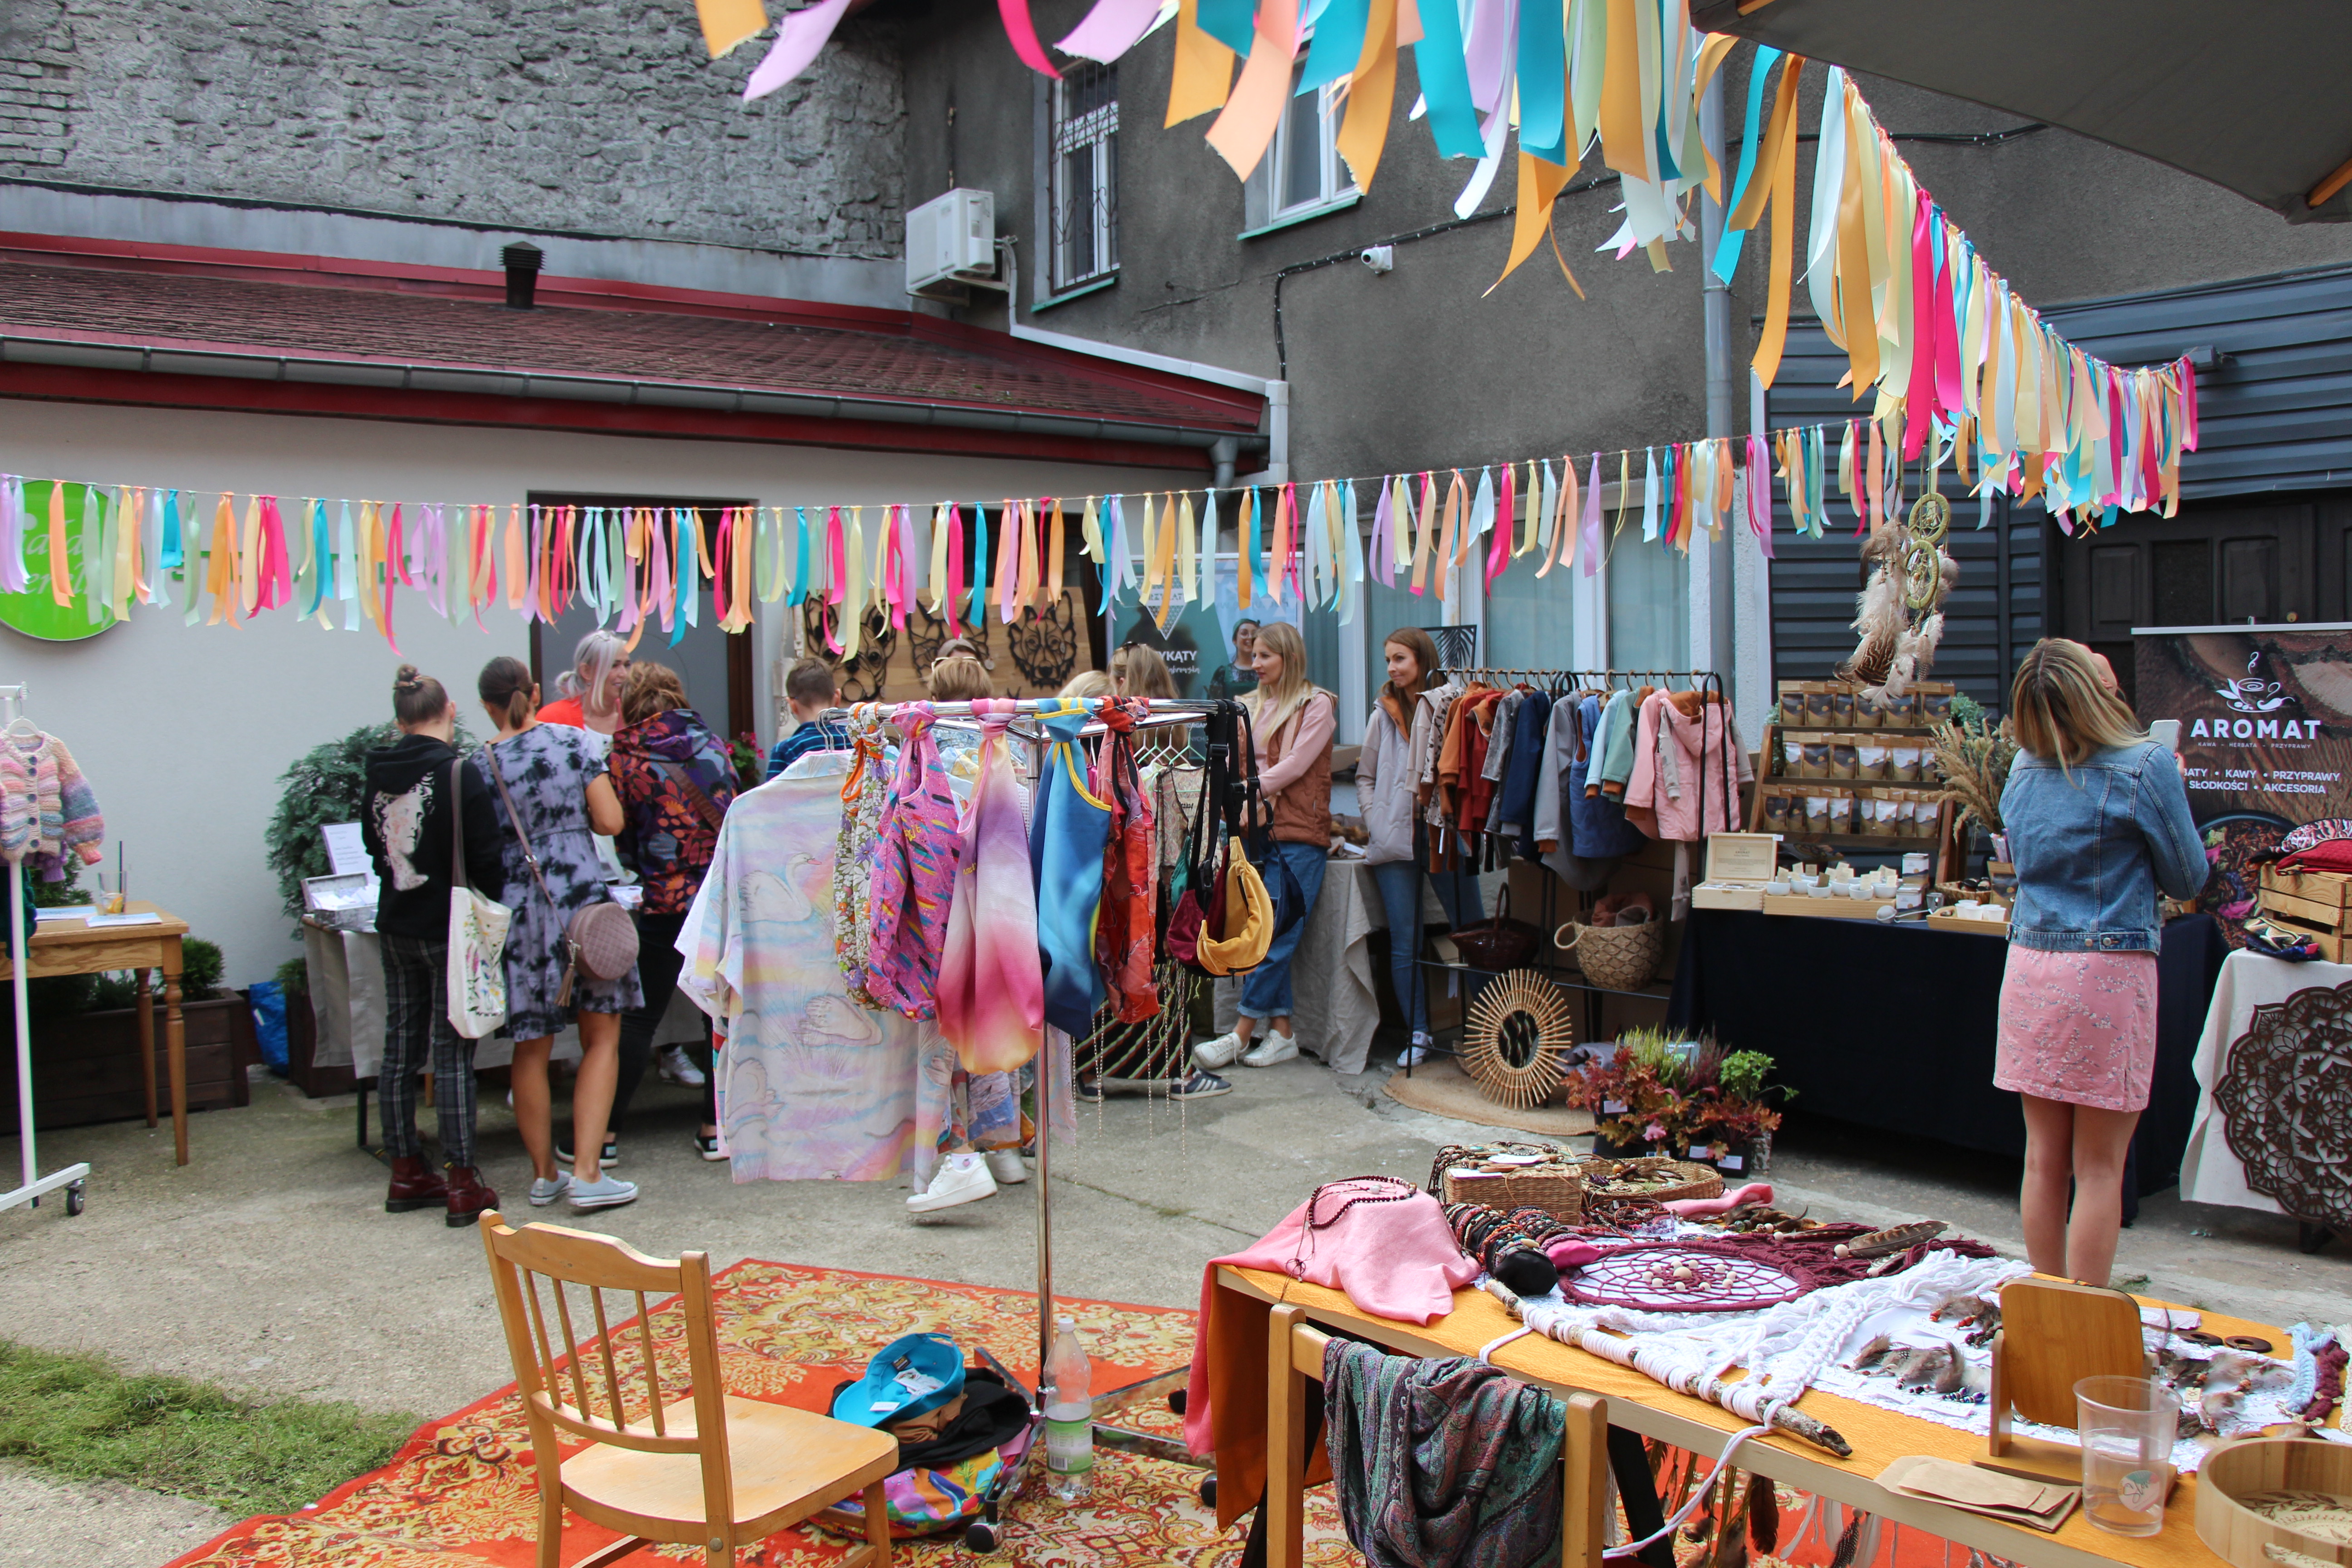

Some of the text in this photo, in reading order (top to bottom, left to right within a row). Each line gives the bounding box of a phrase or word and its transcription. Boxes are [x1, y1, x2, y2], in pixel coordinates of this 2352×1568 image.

[1156, 651, 1197, 663] YKĄTY
[2190, 719, 2321, 740] AROMAT
[2184, 768, 2340, 781] BATY KAWY PRZYPRAWY
[2189, 779, 2326, 794] SŁODKOŚCI AKCESORIA
